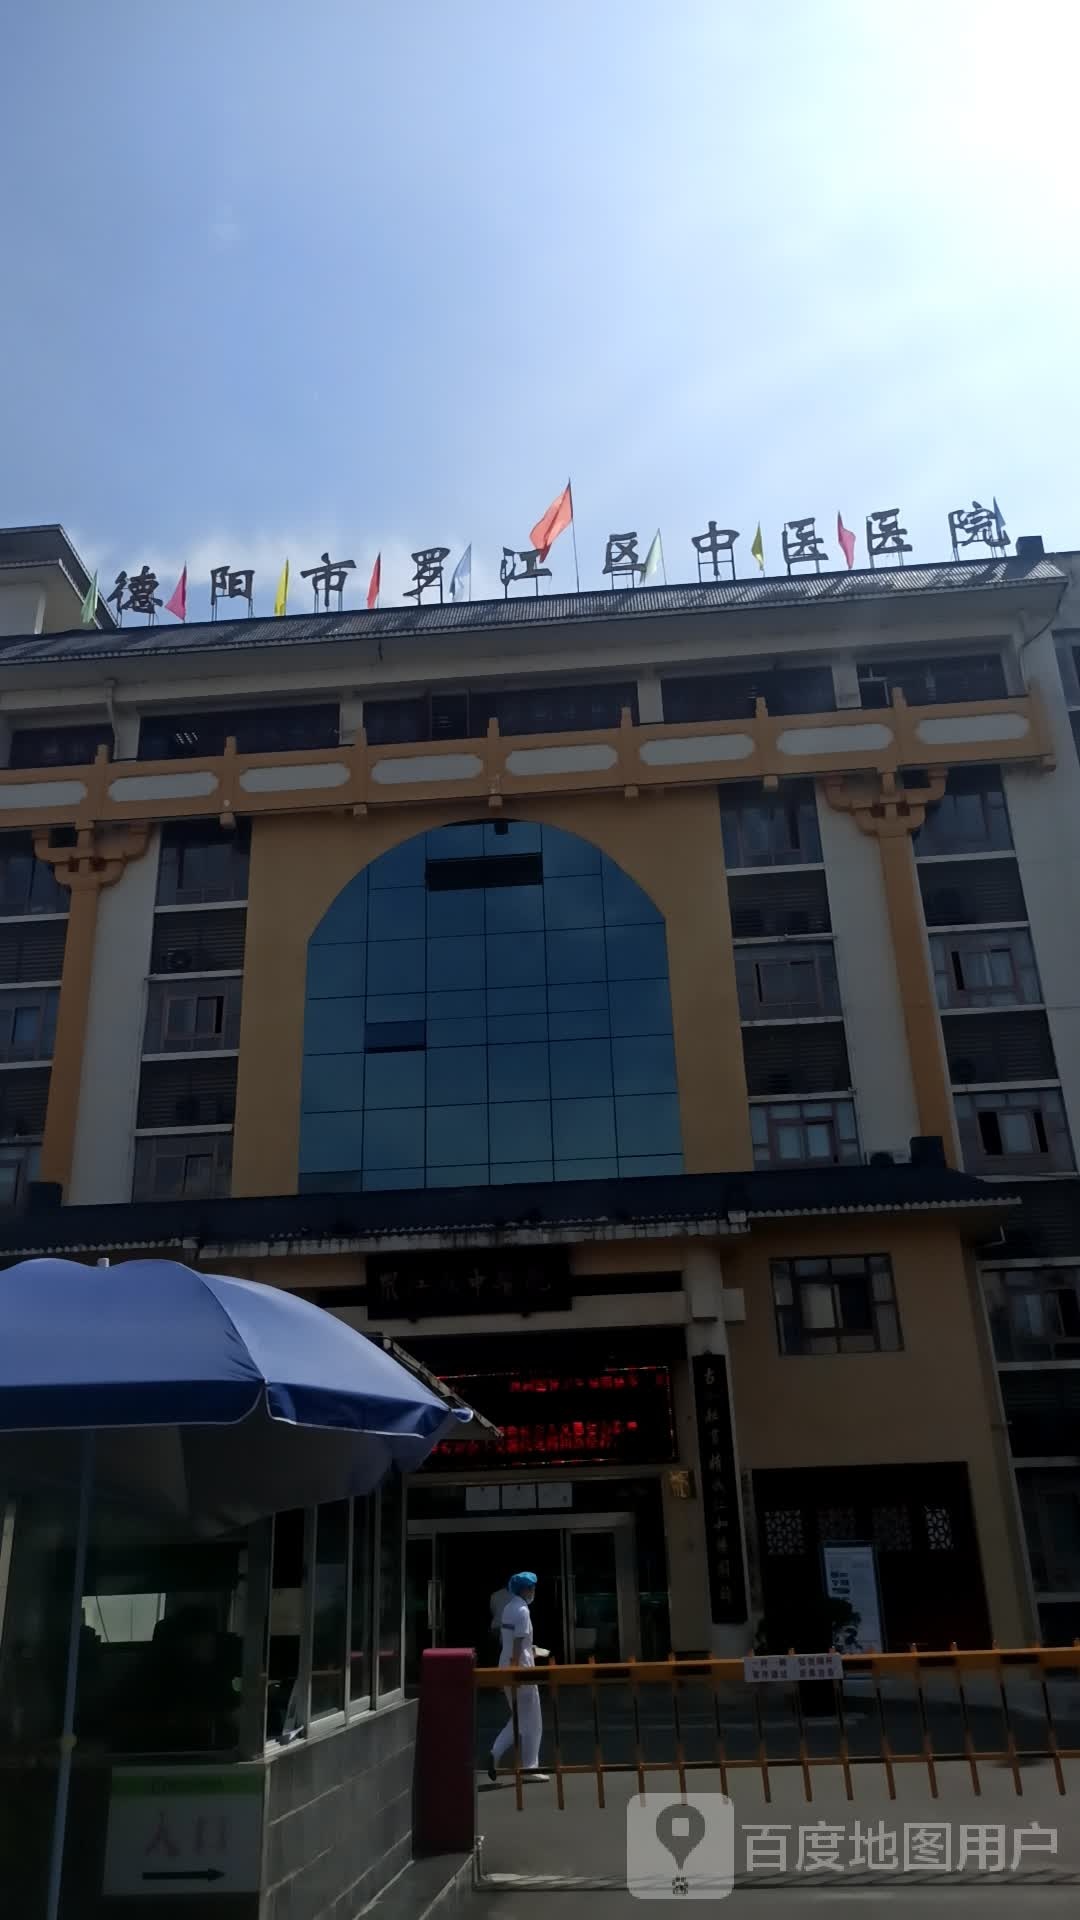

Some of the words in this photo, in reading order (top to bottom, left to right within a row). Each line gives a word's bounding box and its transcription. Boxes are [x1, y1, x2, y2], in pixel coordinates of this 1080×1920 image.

[108, 500, 1010, 614] 德阳市罗江区中医医院
